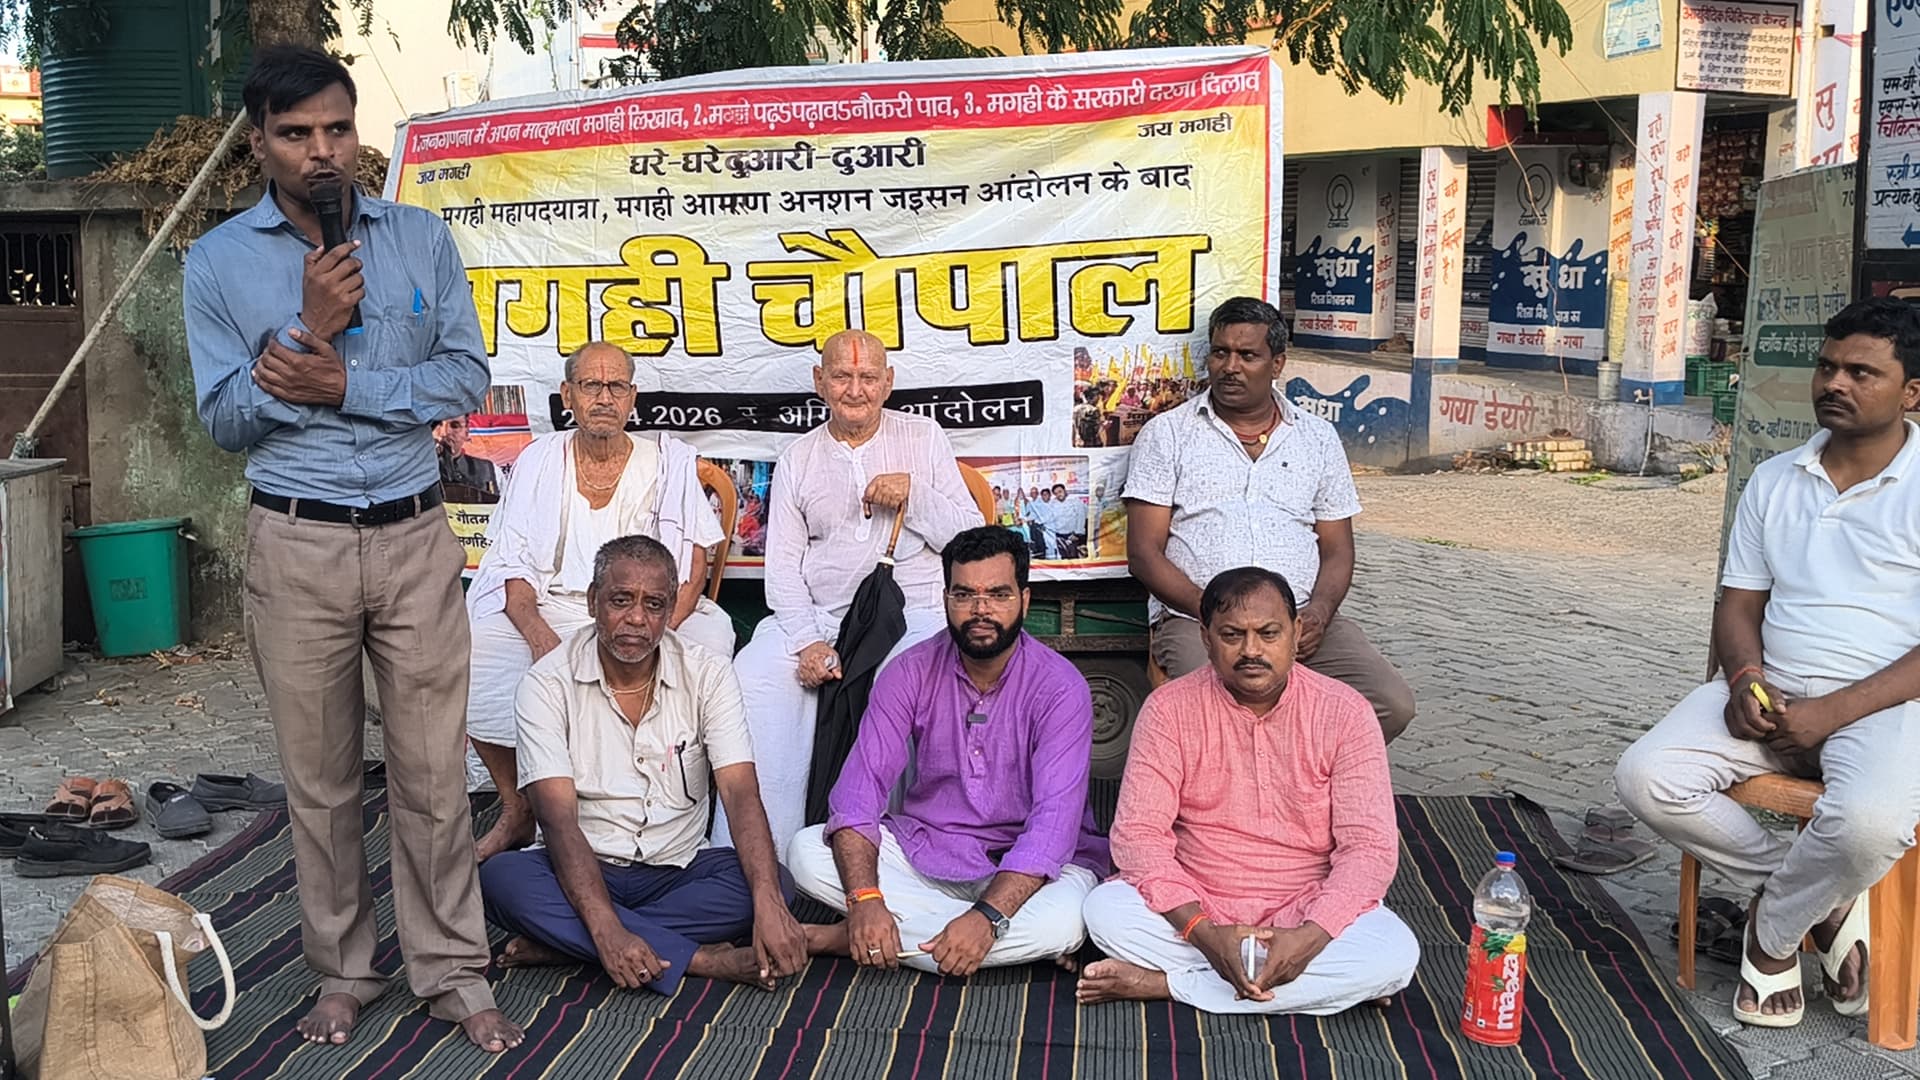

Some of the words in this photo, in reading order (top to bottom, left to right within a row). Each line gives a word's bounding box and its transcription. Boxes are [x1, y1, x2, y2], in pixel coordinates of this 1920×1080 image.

[474, 121, 486, 144] में
[487, 123, 520, 143] अपन
[523, 117, 581, 145] मातृभाषा
[583, 106, 625, 133] मगही
[628, 104, 689, 131] लिखाव,
[917, 96, 959, 118] पाव,
[987, 85, 1042, 114] मगही
[1072, 79, 1146, 110] सरकारी
[1201, 70, 1260, 95] दिलाव
[1138, 121, 1172, 138] जय
[1179, 112, 1232, 134] मगही
[417, 169, 435, 184] जय
[438, 163, 471, 181] मगही
[614, 187, 674, 220] मगही
[779, 189, 874, 214] अनशन
[880, 184, 969, 215] जइसन
[977, 170, 1092, 203] आंदोलन
[1099, 161, 1130, 192] के
[1137, 164, 1192, 190] बाद
[1314, 256, 1360, 288] सुधा
[1520, 265, 1587, 299] सुधा
[746, 228, 1212, 355] चौपाल
[1519, 328, 1546, 345] डेयरी
[1439, 396, 1478, 425] गया
[1484, 390, 1537, 433] डेयरी
[1497, 953, 1520, 1030] maaza
